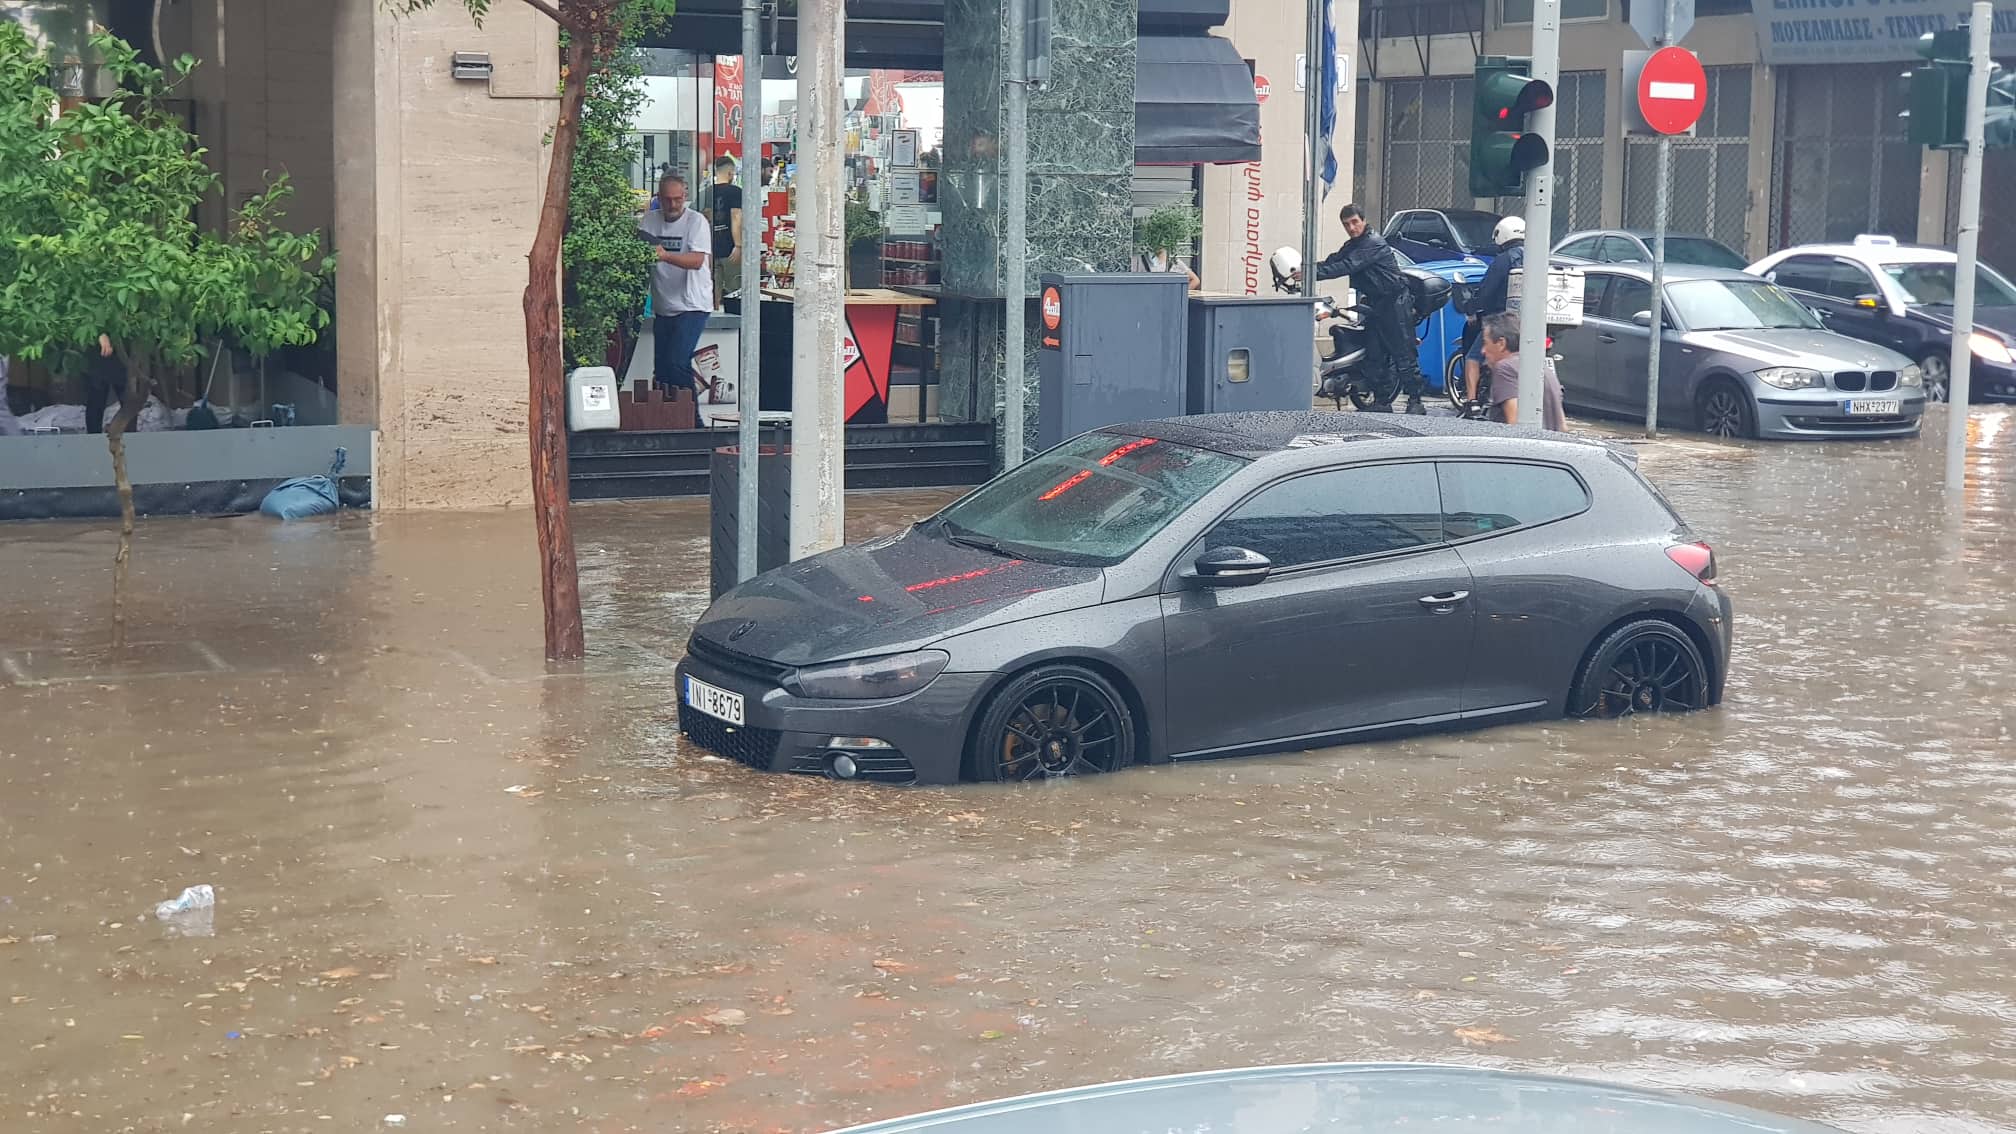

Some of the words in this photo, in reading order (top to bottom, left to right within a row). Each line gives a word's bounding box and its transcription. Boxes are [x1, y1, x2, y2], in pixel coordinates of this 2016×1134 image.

[1771, 19, 1872, 42] ΜΟΥΣΑΜΑΔΕΣ
[1243, 162, 1264, 201] ψιλι
[692, 682, 741, 721] INI-8679
